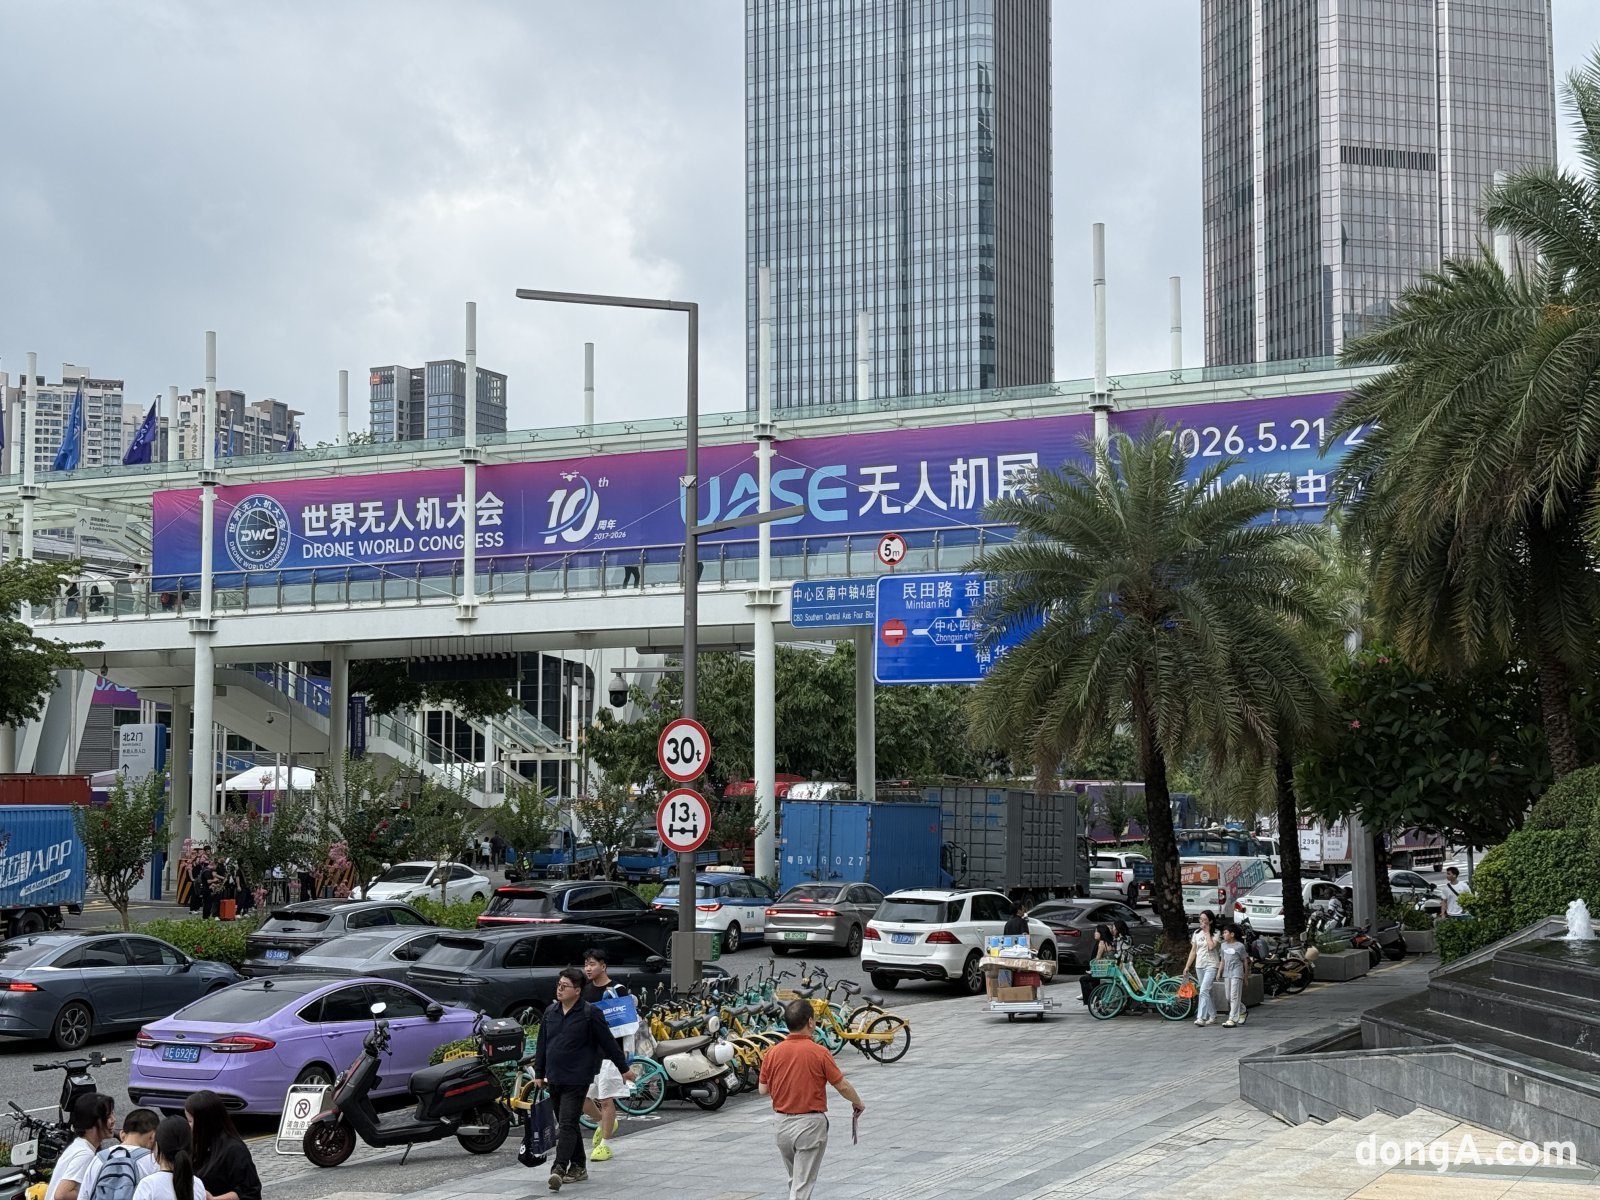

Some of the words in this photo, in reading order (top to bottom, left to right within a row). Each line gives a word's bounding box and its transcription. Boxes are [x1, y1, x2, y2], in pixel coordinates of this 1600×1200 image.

[598, 477, 609, 487] th
[859, 452, 1038, 517] 无人机展
[301, 491, 504, 537] 世界无人机大会
[544, 487, 599, 544] 10
[240, 528, 275, 541] DWC
[303, 541, 354, 559] DRONE
[359, 537, 415, 555] WORLD
[419, 532, 504, 551] CONGESS
[884, 543, 900, 557] 5m
[793, 584, 876, 603] 中心区南中轴4座
[902, 580, 953, 599] 民田路
[905, 600, 936, 609] Mintian
[938, 599, 950, 608] Rd
[935, 633, 964, 643] Zhongxin
[123, 732, 143, 742] 北2门
[666, 737, 701, 764] 30t
[671, 802, 697, 822] 13t
[29, 839, 72, 877] APP
